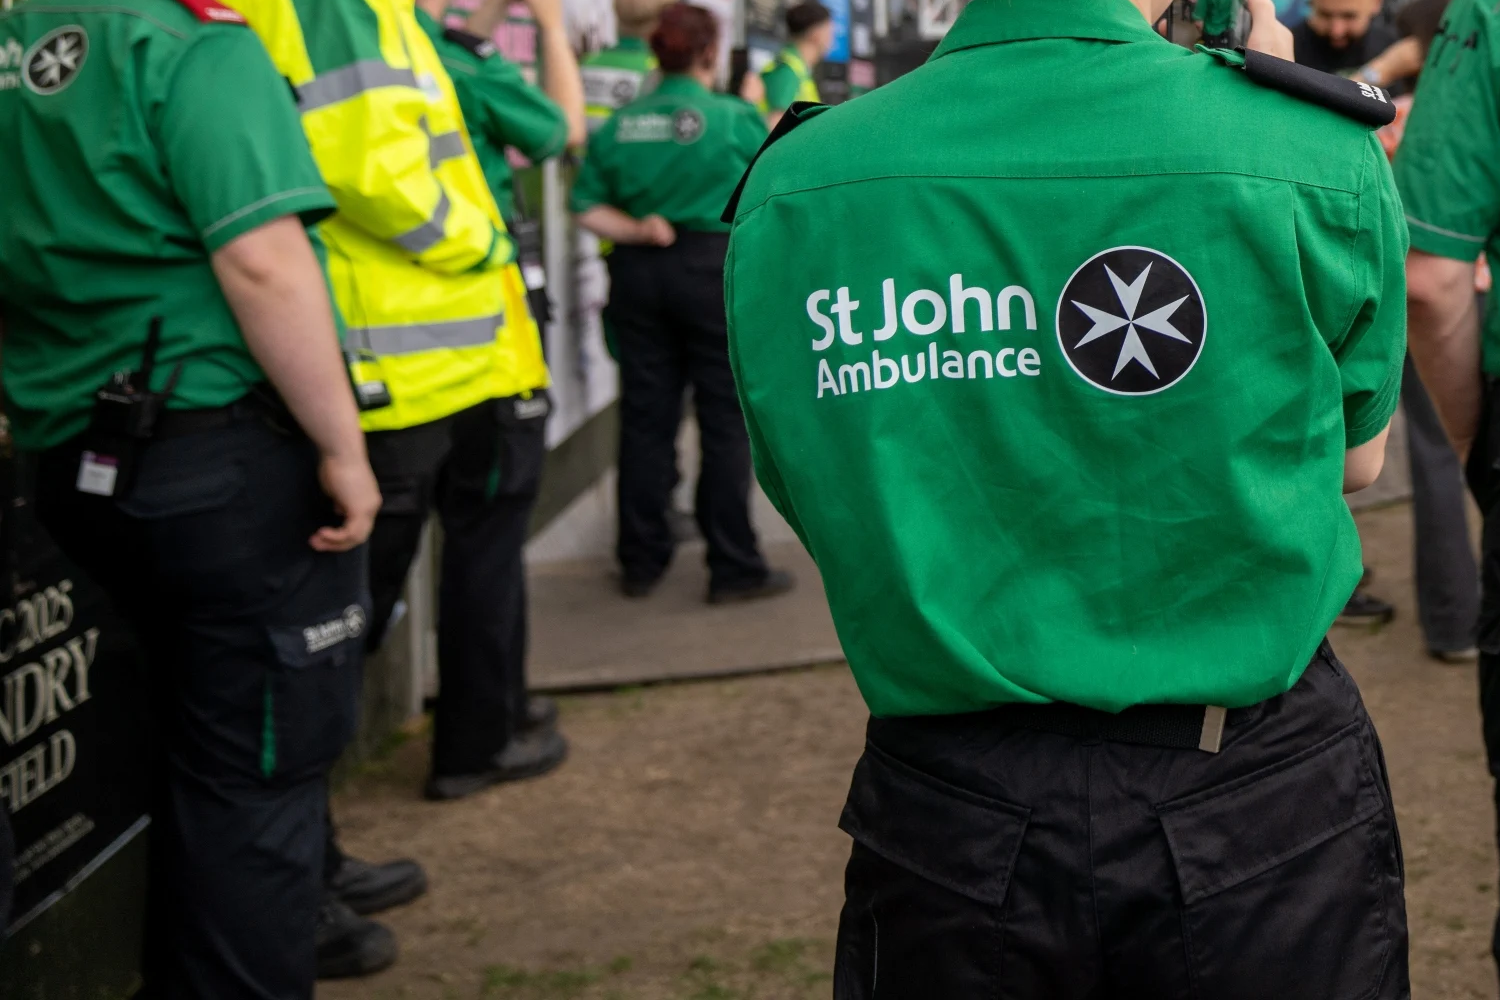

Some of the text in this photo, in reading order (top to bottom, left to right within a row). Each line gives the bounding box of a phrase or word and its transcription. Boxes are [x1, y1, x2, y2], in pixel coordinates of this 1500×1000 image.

[805, 273, 1038, 352] St John
[816, 341, 1042, 399] Ambulance
